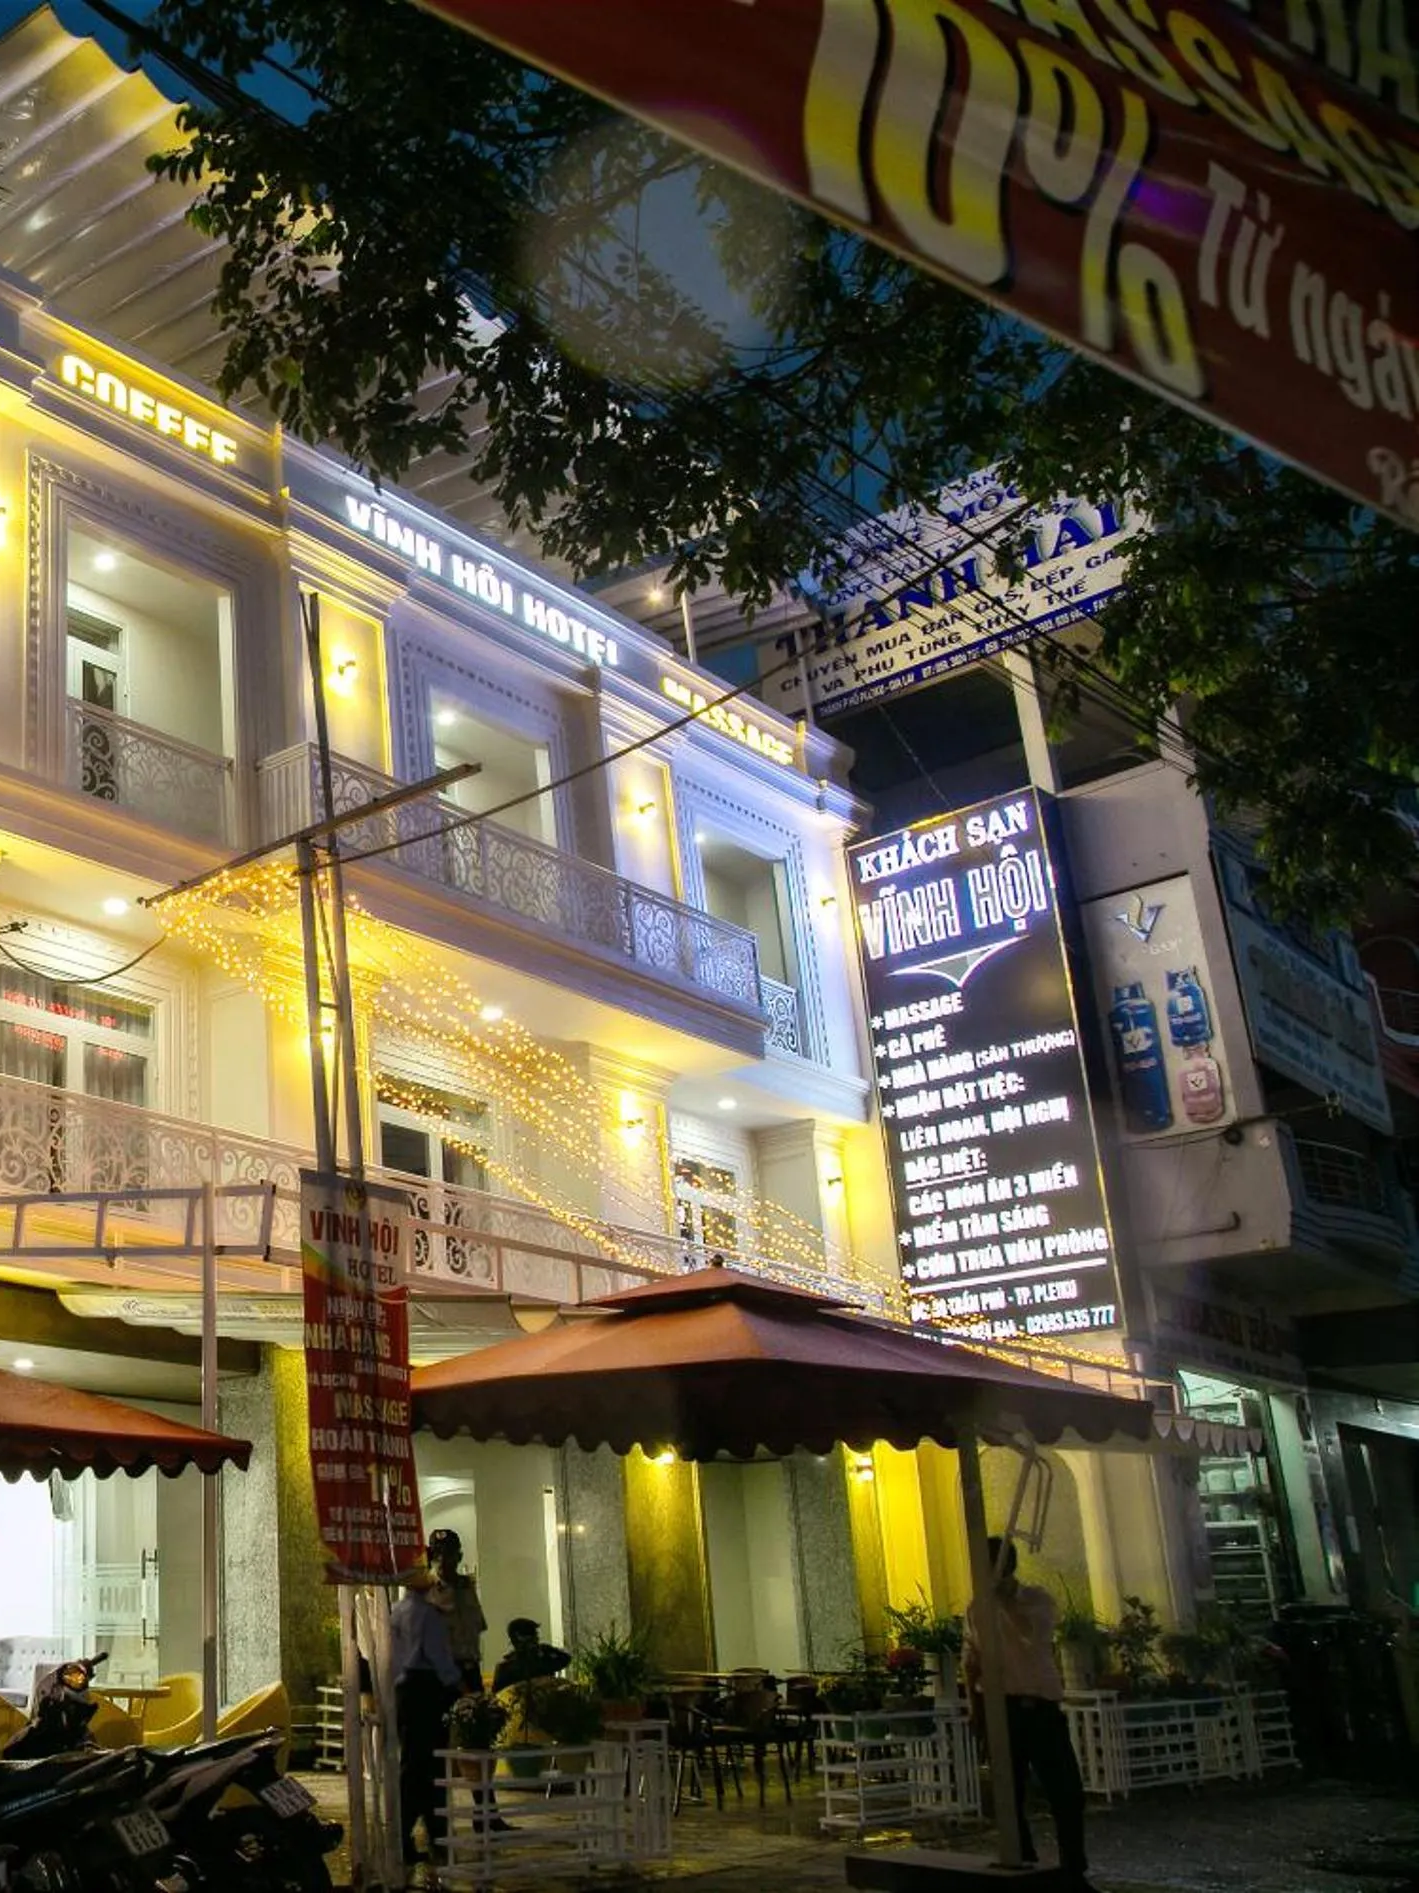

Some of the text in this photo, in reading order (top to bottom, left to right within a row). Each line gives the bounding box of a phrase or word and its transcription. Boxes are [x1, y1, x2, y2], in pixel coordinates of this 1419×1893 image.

[1197, 159, 1285, 341] Từ
[345, 495, 442, 576] VĨNH
[523, 592, 618, 669] HOTEL
[866, 632, 913, 658] MUA
[662, 676, 794, 766] MASSAGE
[856, 801, 1029, 884] KHÁCH SẠN
[858, 843, 1048, 961] VĨNH HỘI
[883, 991, 965, 1031] MASSAGE
[887, 1033, 913, 1059] CÀ
[309, 1206, 361, 1248] VĨNH
[1000, 1204, 1051, 1233] SÁNG
